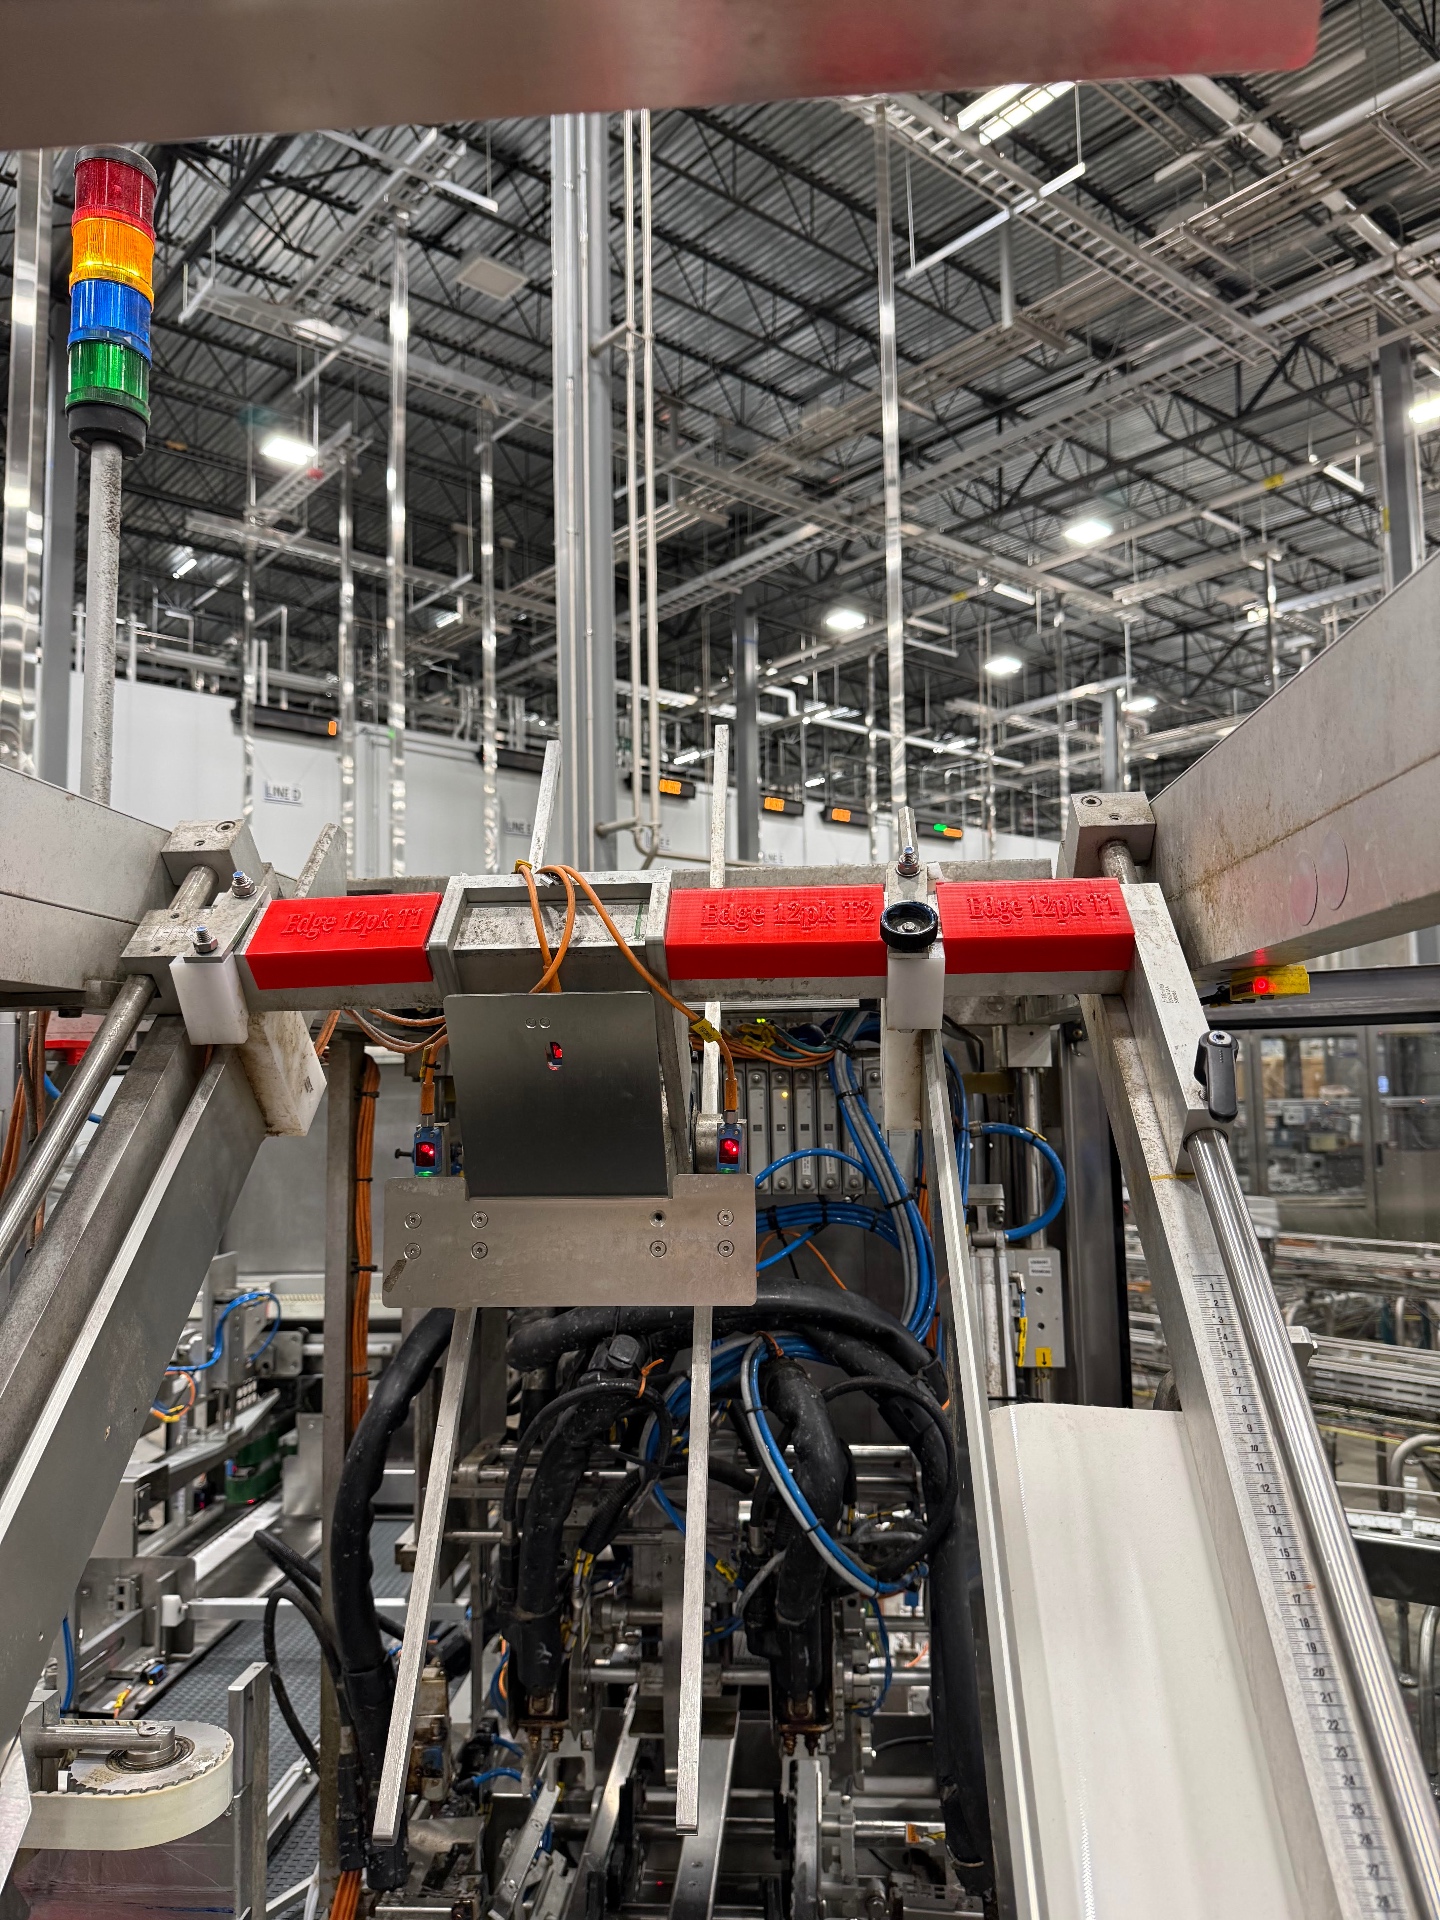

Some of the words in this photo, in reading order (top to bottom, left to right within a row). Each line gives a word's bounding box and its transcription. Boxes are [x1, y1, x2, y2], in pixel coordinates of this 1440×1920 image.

[966, 895, 1023, 926] Edge
[1027, 893, 1086, 924] 12pk
[1087, 892, 1120, 917] T1
[701, 902, 765, 932] Edge
[772, 899, 836, 932] 12pk
[841, 899, 875, 925] T2
[281, 912, 337, 940] Edge
[340, 908, 393, 939] 12pk
[398, 907, 424, 931] T1
[1210, 1283, 1214, 1291] 1
[1227, 1350, 1233, 1358] 5
[1232, 1368, 1237, 1376] 6
[1247, 1424, 1253, 1432] 9
[1256, 1463, 1264, 1471] 11
[1261, 1484, 1271, 1492] 12
[1267, 1505, 1277, 1513] 13
[1273, 1526, 1282, 1535] 14
[1279, 1548, 1290, 1557] 15
[1285, 1571, 1296, 1580] 16
[1292, 1594, 1301, 1603] 17
[1299, 1617, 1310, 1627] 18
[1306, 1642, 1317, 1653] 19
[1313, 1667, 1325, 1677] 20
[1320, 1691, 1333, 1703] 21
[1326, 1719, 1340, 1730] 22
[1334, 1746, 1348, 1758] 23
[1342, 1774, 1355, 1786] 24
[1366, 1863, 1379, 1876] 27
